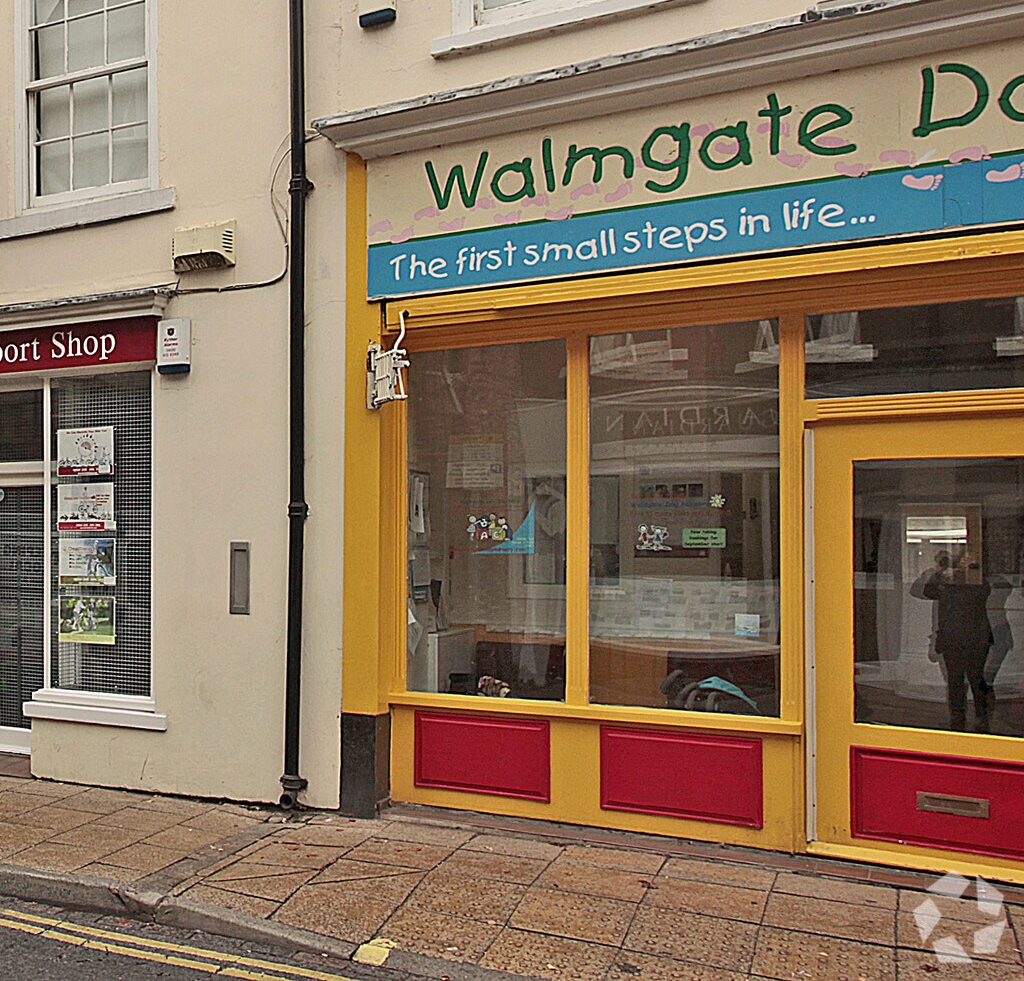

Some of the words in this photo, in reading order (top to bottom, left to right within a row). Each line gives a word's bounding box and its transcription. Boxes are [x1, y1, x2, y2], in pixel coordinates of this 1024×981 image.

[425, 93, 858, 210] Walmgate
[389, 254, 448, 281] The
[456, 240, 517, 275] first
[523, 228, 617, 266] small
[622, 218, 728, 253] steps
[738, 207, 771, 236] in
[782, 198, 876, 231] life...
[51, 330, 117, 360] Shop
